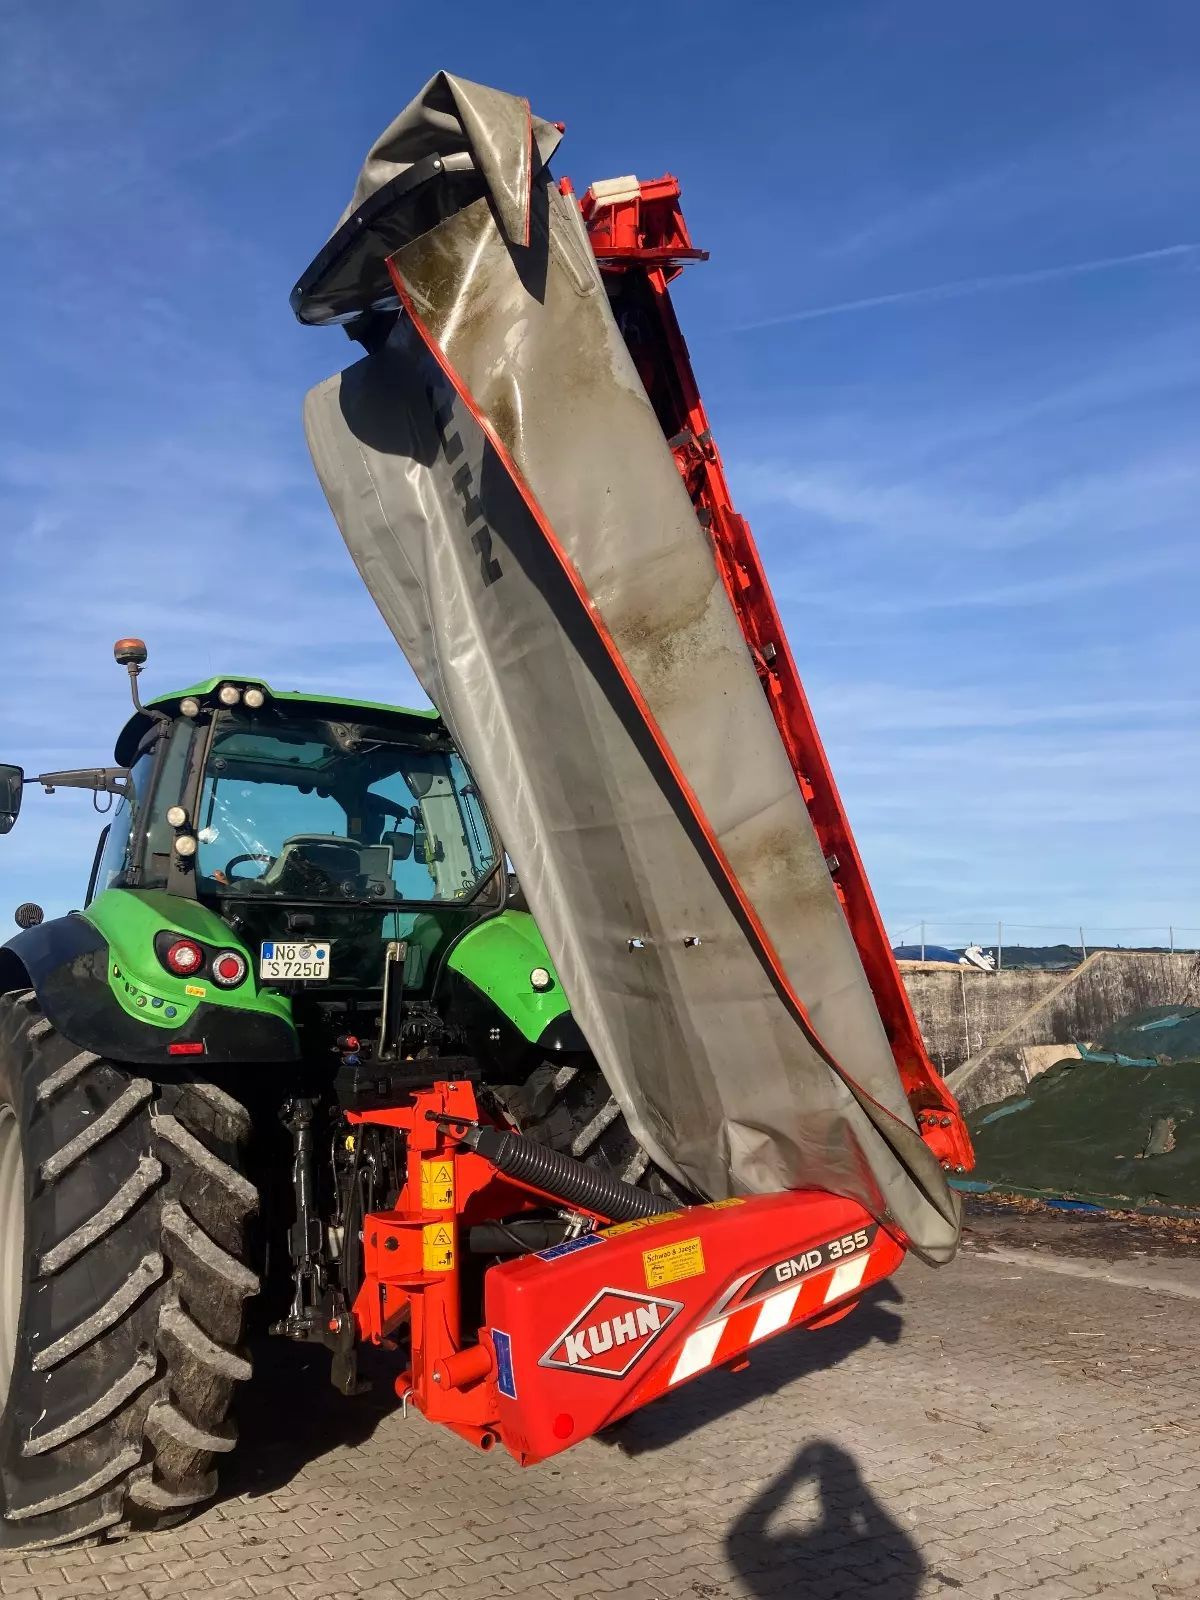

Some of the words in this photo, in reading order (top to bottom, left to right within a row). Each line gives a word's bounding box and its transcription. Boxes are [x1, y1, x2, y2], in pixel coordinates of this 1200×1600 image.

[271, 962, 279, 976] S
[775, 1250, 822, 1282] GMD
[828, 1229, 869, 1260] 355
[564, 1302, 661, 1365] KUHN
